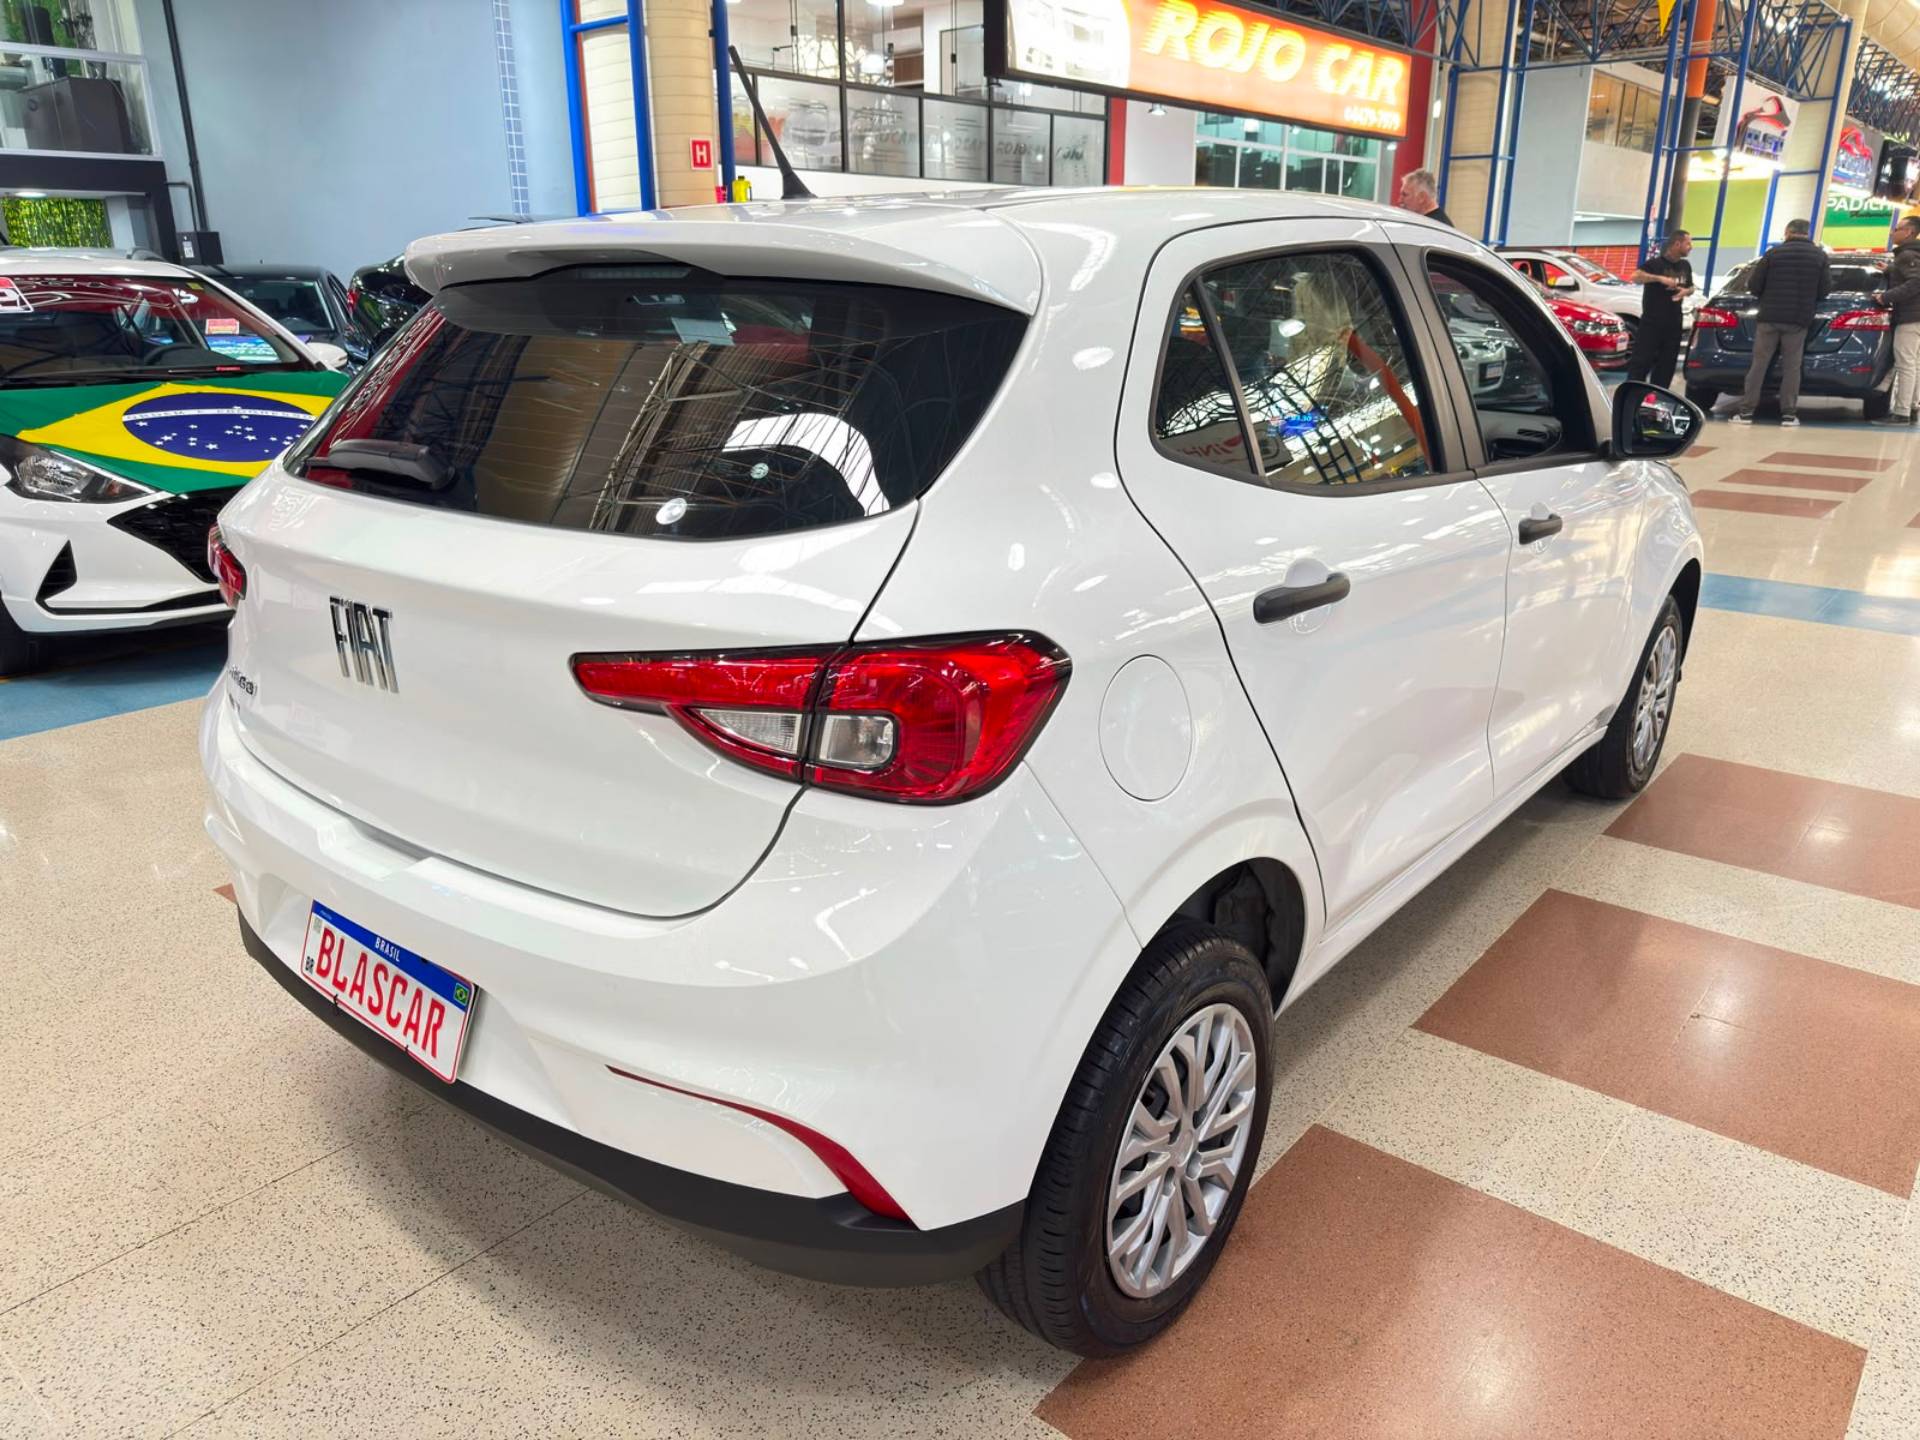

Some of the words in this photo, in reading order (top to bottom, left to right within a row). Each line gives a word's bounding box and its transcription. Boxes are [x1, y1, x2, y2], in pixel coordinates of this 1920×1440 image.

[1141, 0, 1306, 82] ROJO
[1312, 43, 1404, 106] CAR
[695, 143, 708, 164] H
[329, 595, 400, 693] FIAT
[315, 927, 446, 1059] BLASCAR
[374, 936, 401, 963] BRASIL
